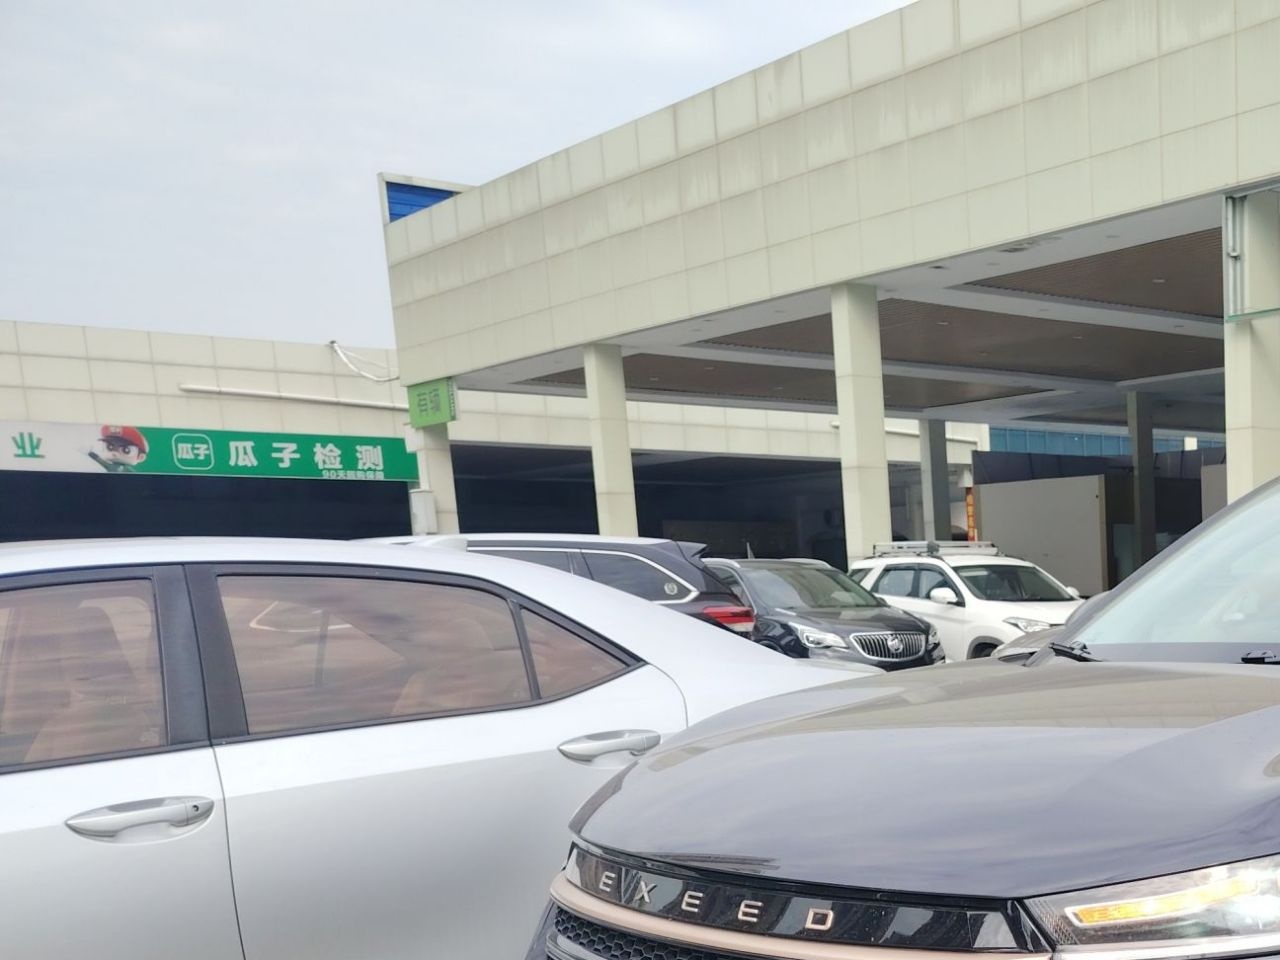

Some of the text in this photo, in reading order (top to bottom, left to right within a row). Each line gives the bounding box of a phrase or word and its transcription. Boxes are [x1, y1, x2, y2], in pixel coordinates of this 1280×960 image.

[12, 432, 46, 459] 业
[177, 443, 209, 460] 瓜子
[229, 440, 384, 471] 瓜子检测
[598, 871, 834, 931] EXEED
